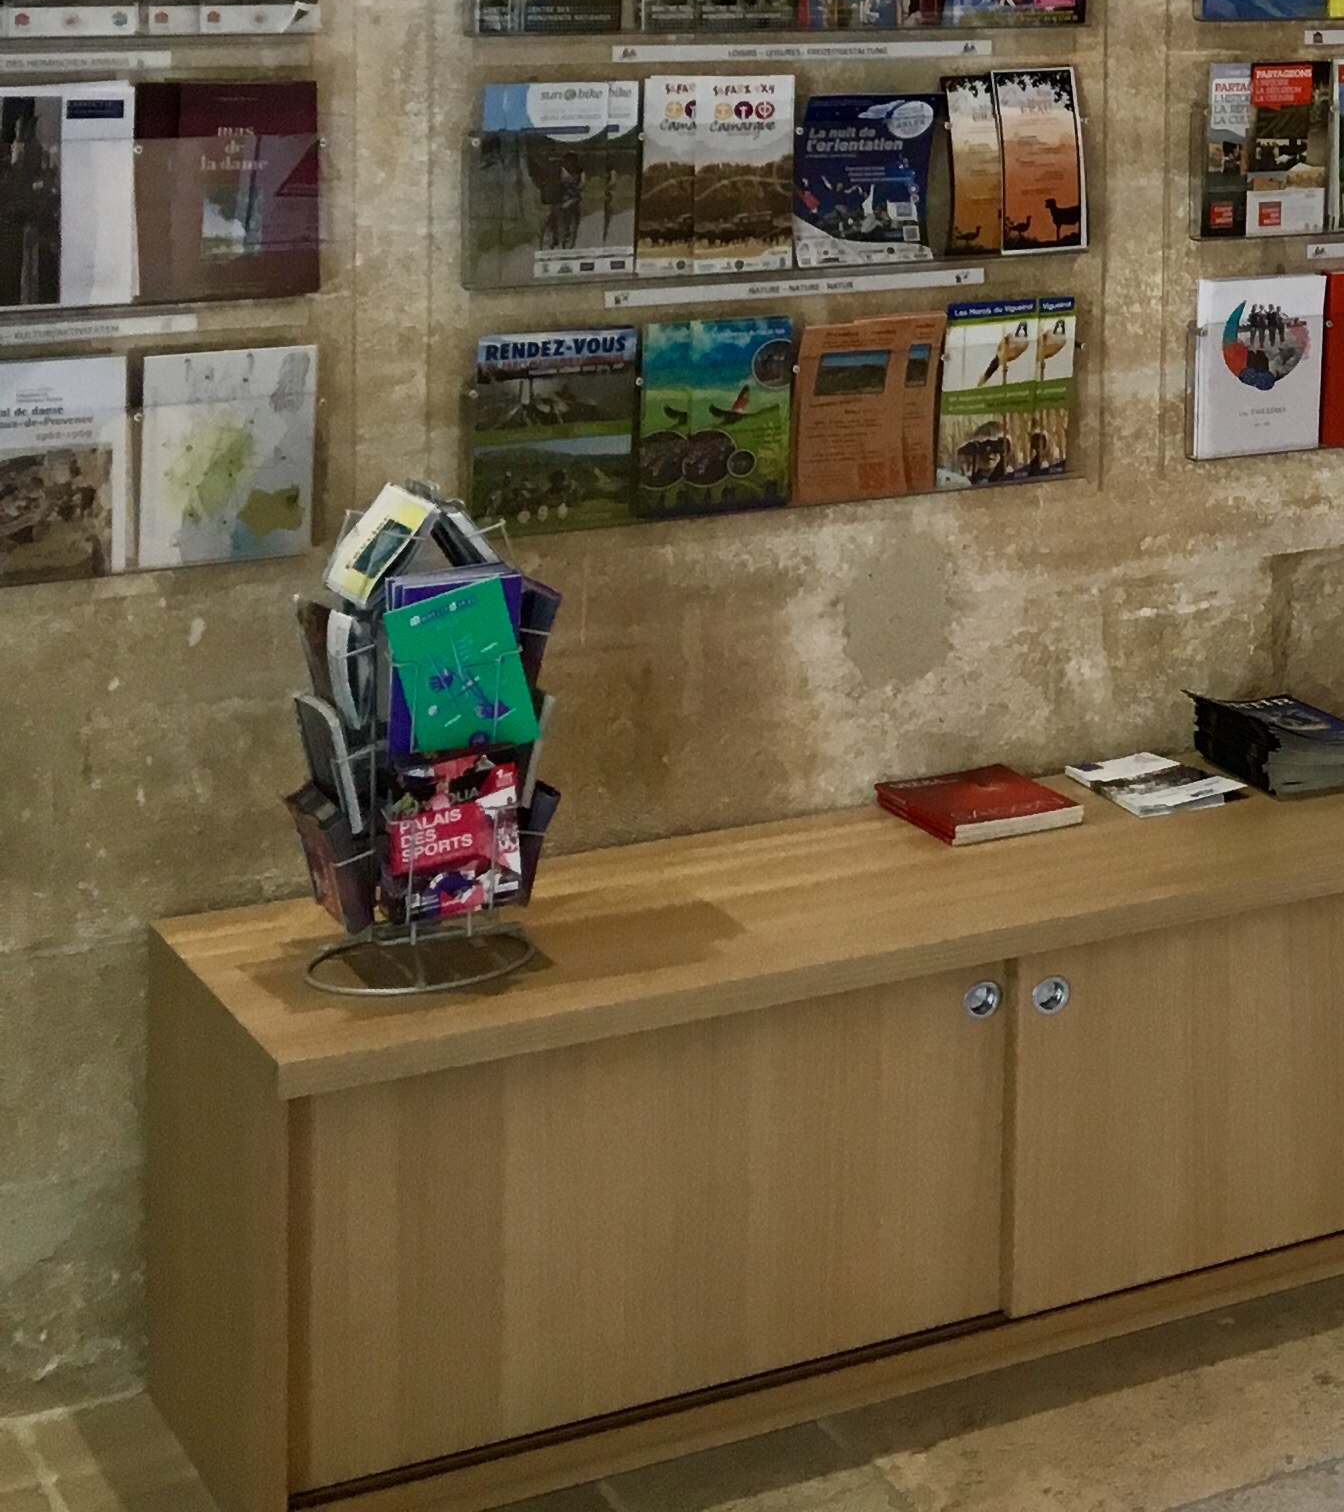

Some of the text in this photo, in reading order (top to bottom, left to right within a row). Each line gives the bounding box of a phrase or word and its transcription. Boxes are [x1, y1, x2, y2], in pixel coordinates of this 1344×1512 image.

[217, 126, 255, 139] mas
[709, 120, 775, 141] Camargue
[808, 126, 876, 139] La nuit de
[225, 141, 243, 155] de
[217, 157, 268, 172] dame
[485, 335, 627, 361] RENDEZ-VOUS
[400, 808, 463, 836] PALAIS
[400, 828, 438, 850] DES
[402, 833, 474, 864] SPORTS
